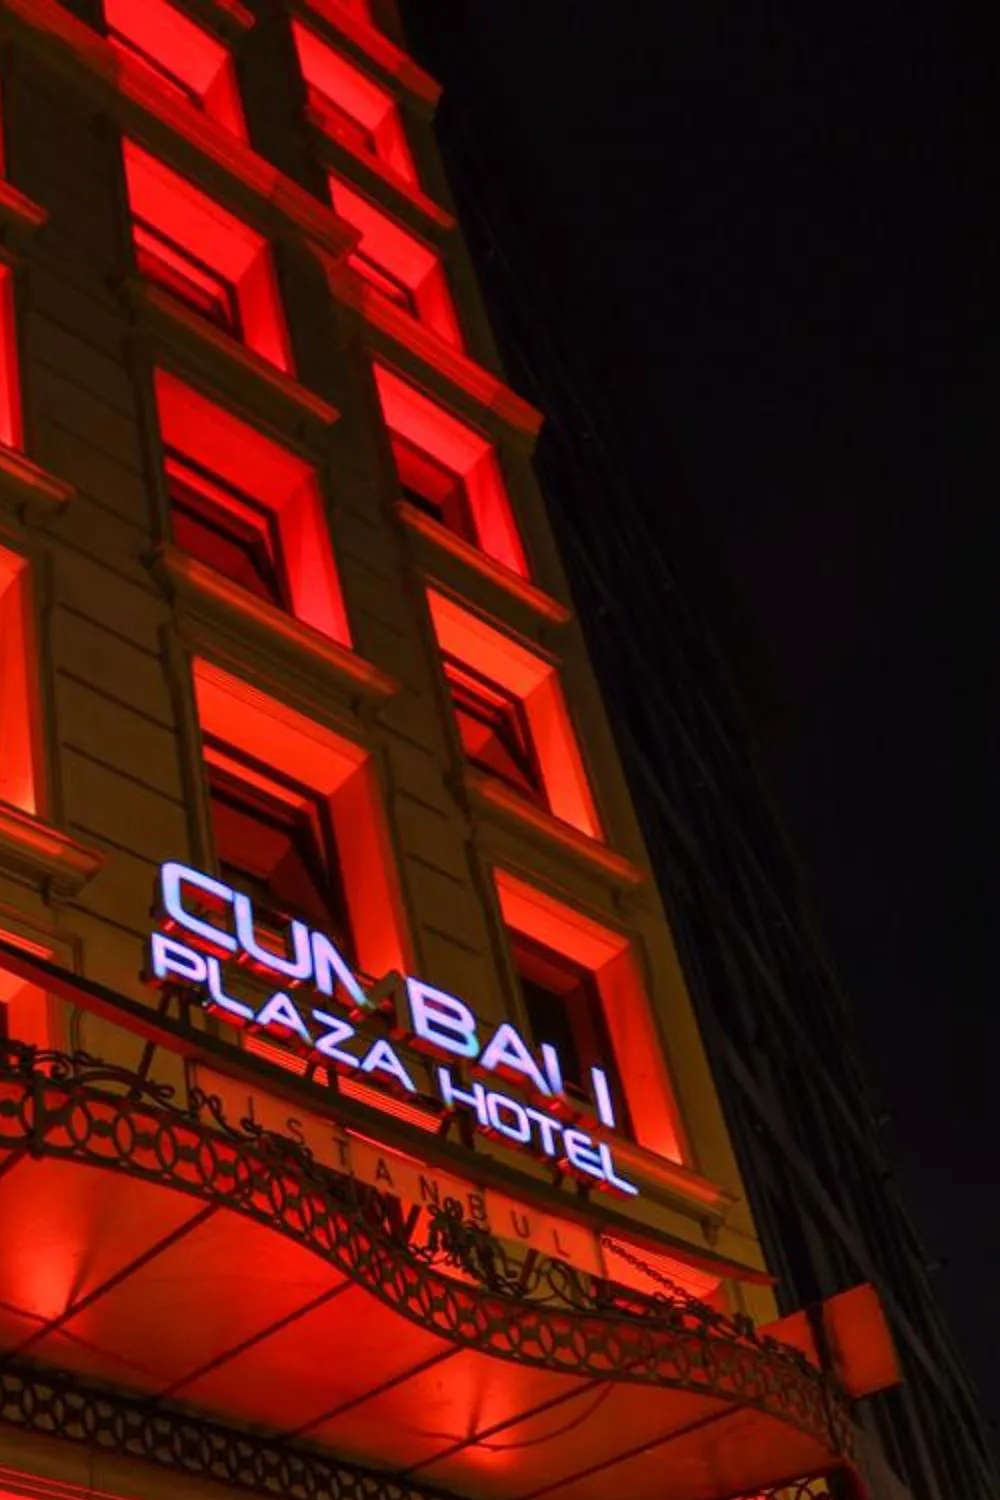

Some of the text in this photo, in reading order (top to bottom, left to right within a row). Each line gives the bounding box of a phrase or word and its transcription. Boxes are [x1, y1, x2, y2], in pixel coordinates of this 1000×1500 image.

[151, 932, 640, 1197] PLAZA HOTEL
[248, 1097, 571, 1259] ISTANBUL
